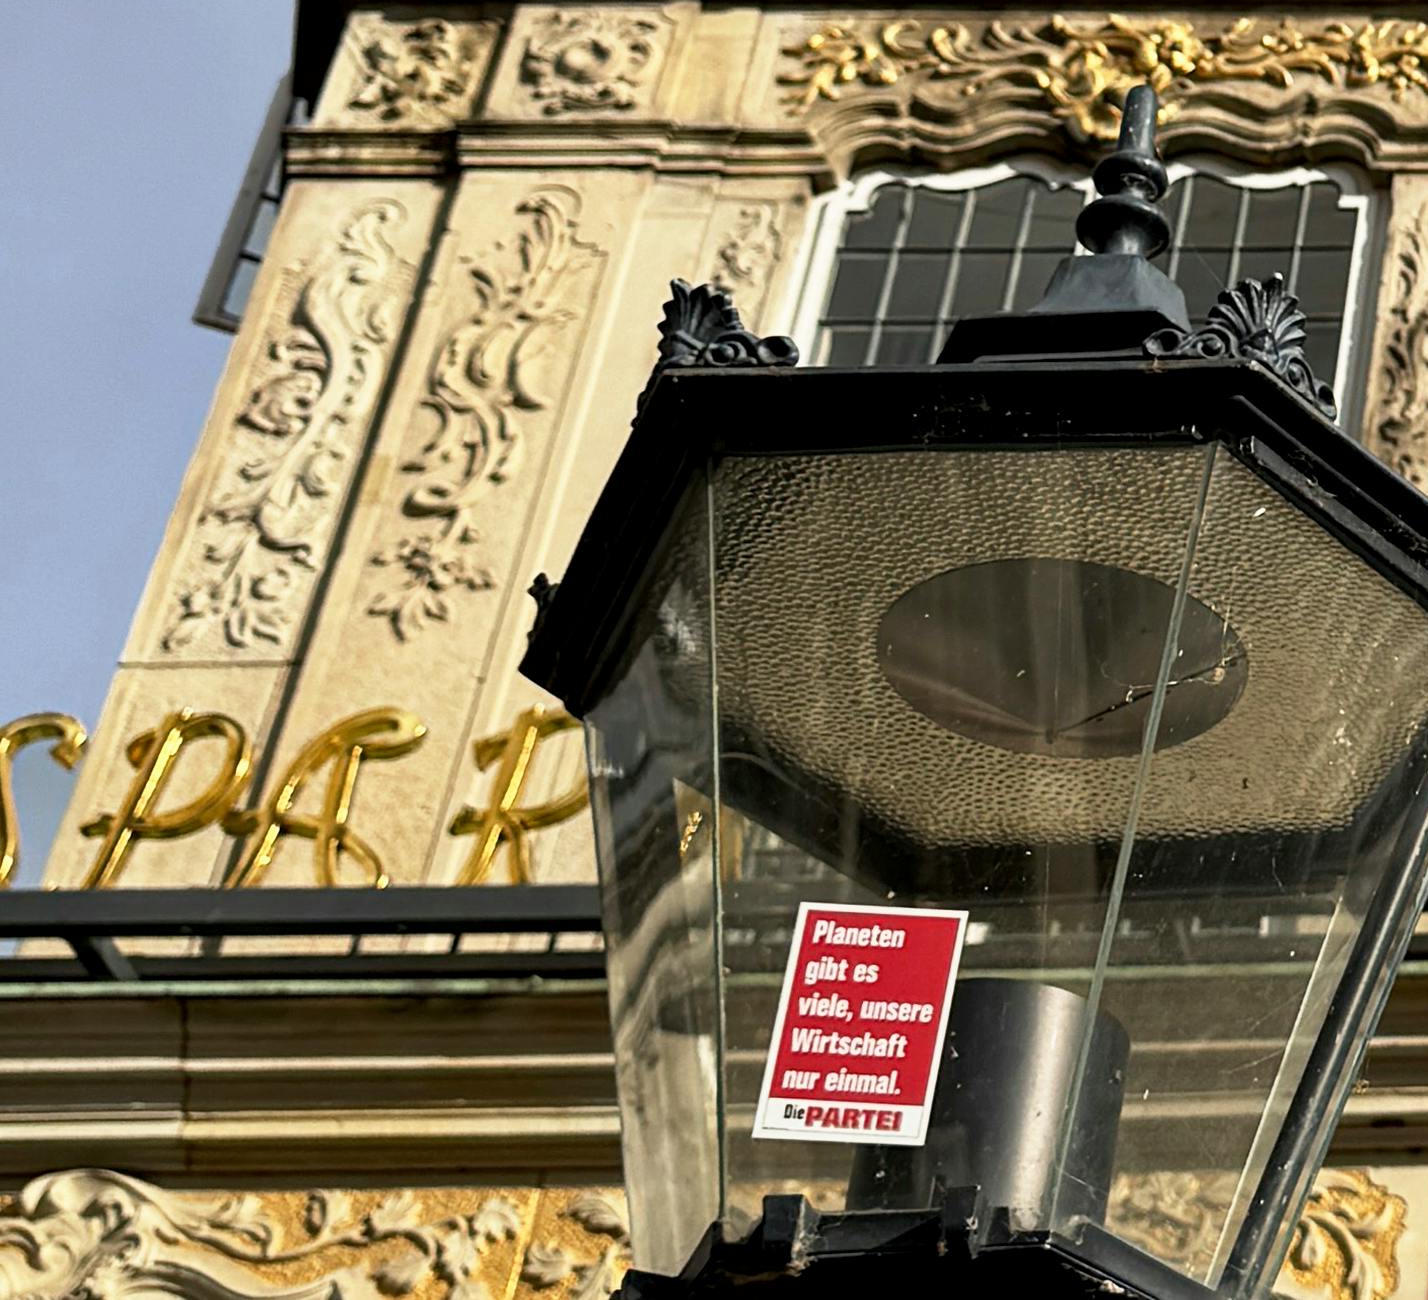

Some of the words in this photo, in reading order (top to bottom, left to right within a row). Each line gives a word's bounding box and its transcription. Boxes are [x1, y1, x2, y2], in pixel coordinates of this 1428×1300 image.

[812, 919, 906, 948] Planeten
[804, 956, 849, 985] gibt
[852, 962, 880, 983] es
[798, 992, 853, 1022] viele,
[860, 1000, 934, 1023] unsere
[791, 1027, 908, 1058] Wirtschaft
[781, 1069, 821, 1090] nur
[824, 1067, 901, 1095] einmal.
[783, 1103, 805, 1120] Die
[804, 1106, 904, 1131] PARTEI
